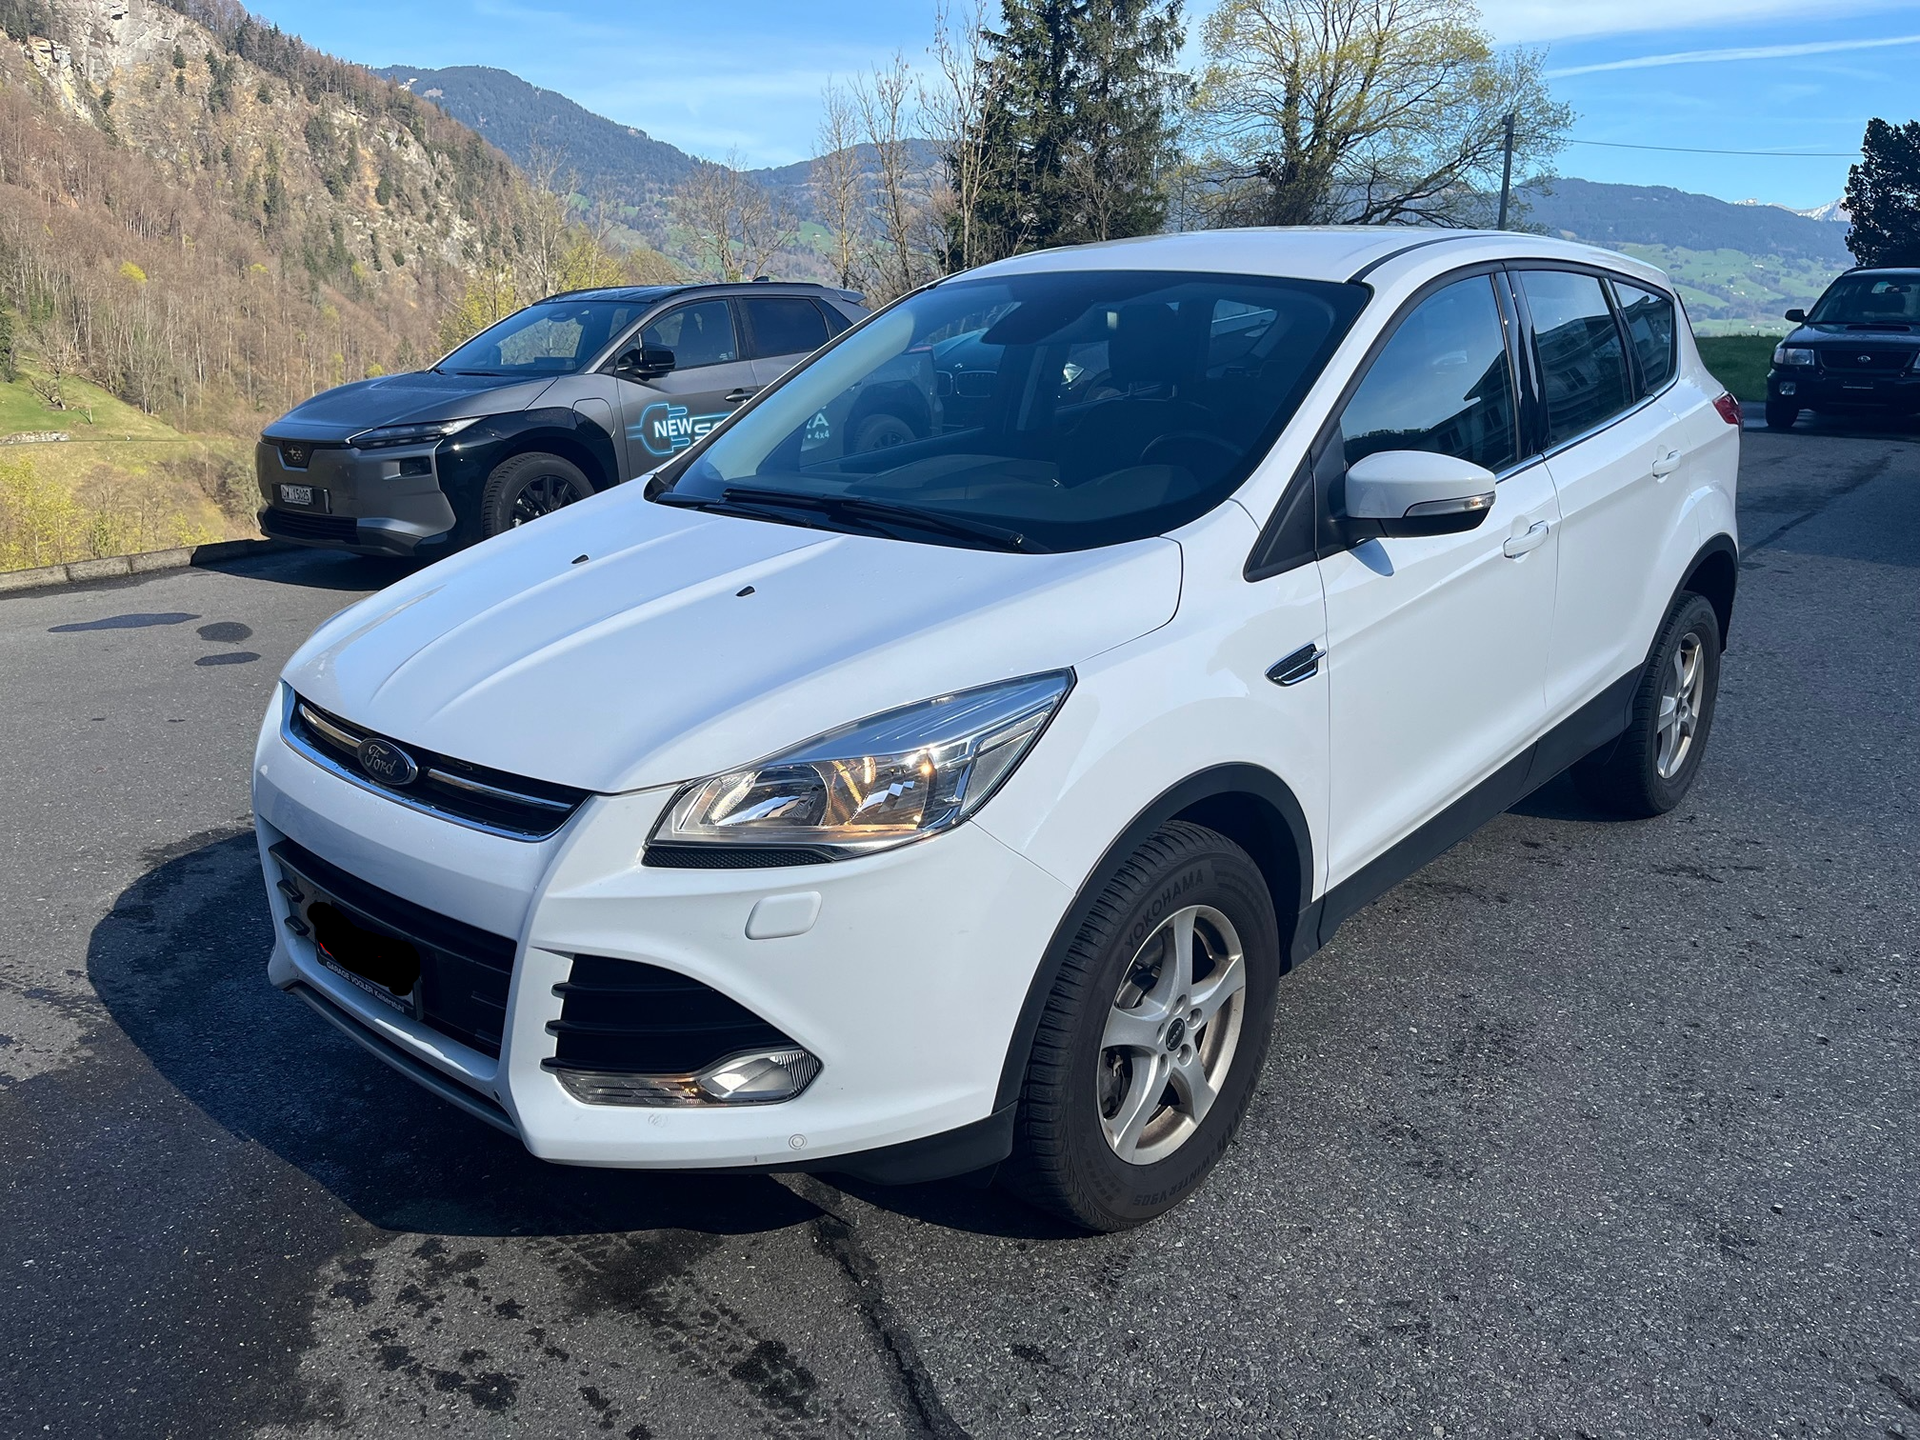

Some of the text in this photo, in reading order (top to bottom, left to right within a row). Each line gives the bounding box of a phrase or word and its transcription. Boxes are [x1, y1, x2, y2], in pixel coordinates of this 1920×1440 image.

[653, 418, 693, 438] NEW
[814, 430, 830, 439] 4x4
[365, 744, 390, 776] Ford
[1124, 869, 1204, 949] YOKOHAMA
[326, 961, 350, 981] GARAGE
[1132, 1190, 1168, 1207] V905
